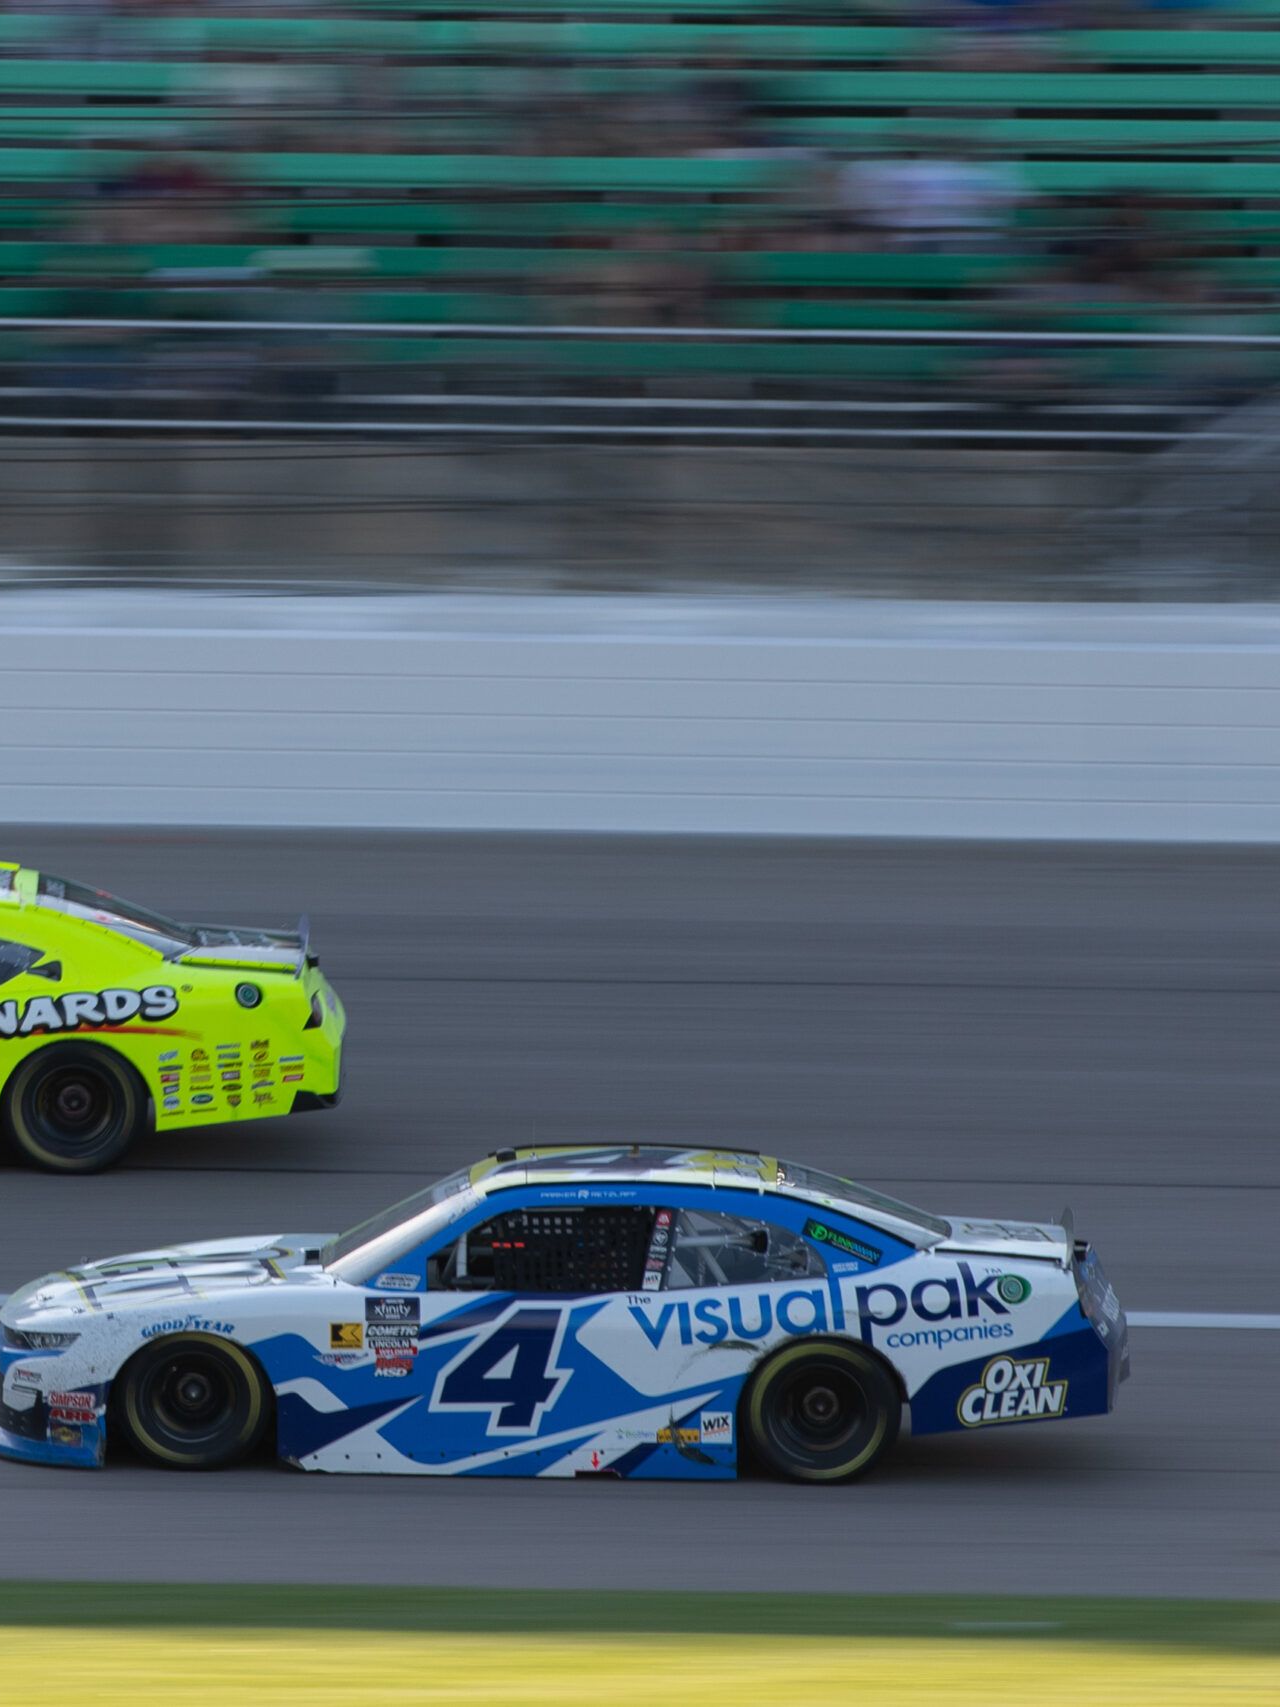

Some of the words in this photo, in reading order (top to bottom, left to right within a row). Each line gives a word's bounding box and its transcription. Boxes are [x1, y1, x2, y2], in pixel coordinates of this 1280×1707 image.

[626, 1294, 652, 1306] The
[855, 1261, 1011, 1349] pak
[374, 1304, 410, 1318] xfinity
[887, 1318, 1014, 1350] companies
[370, 1339, 411, 1349] LINCOLN
[374, 1368, 409, 1378] MSD
[432, 1303, 570, 1434] 4
[984, 1359, 1046, 1394] OXI
[50, 1391, 93, 1409] SIMPSON
[960, 1384, 1064, 1424] CLEAN
[702, 1415, 730, 1432] WIX
